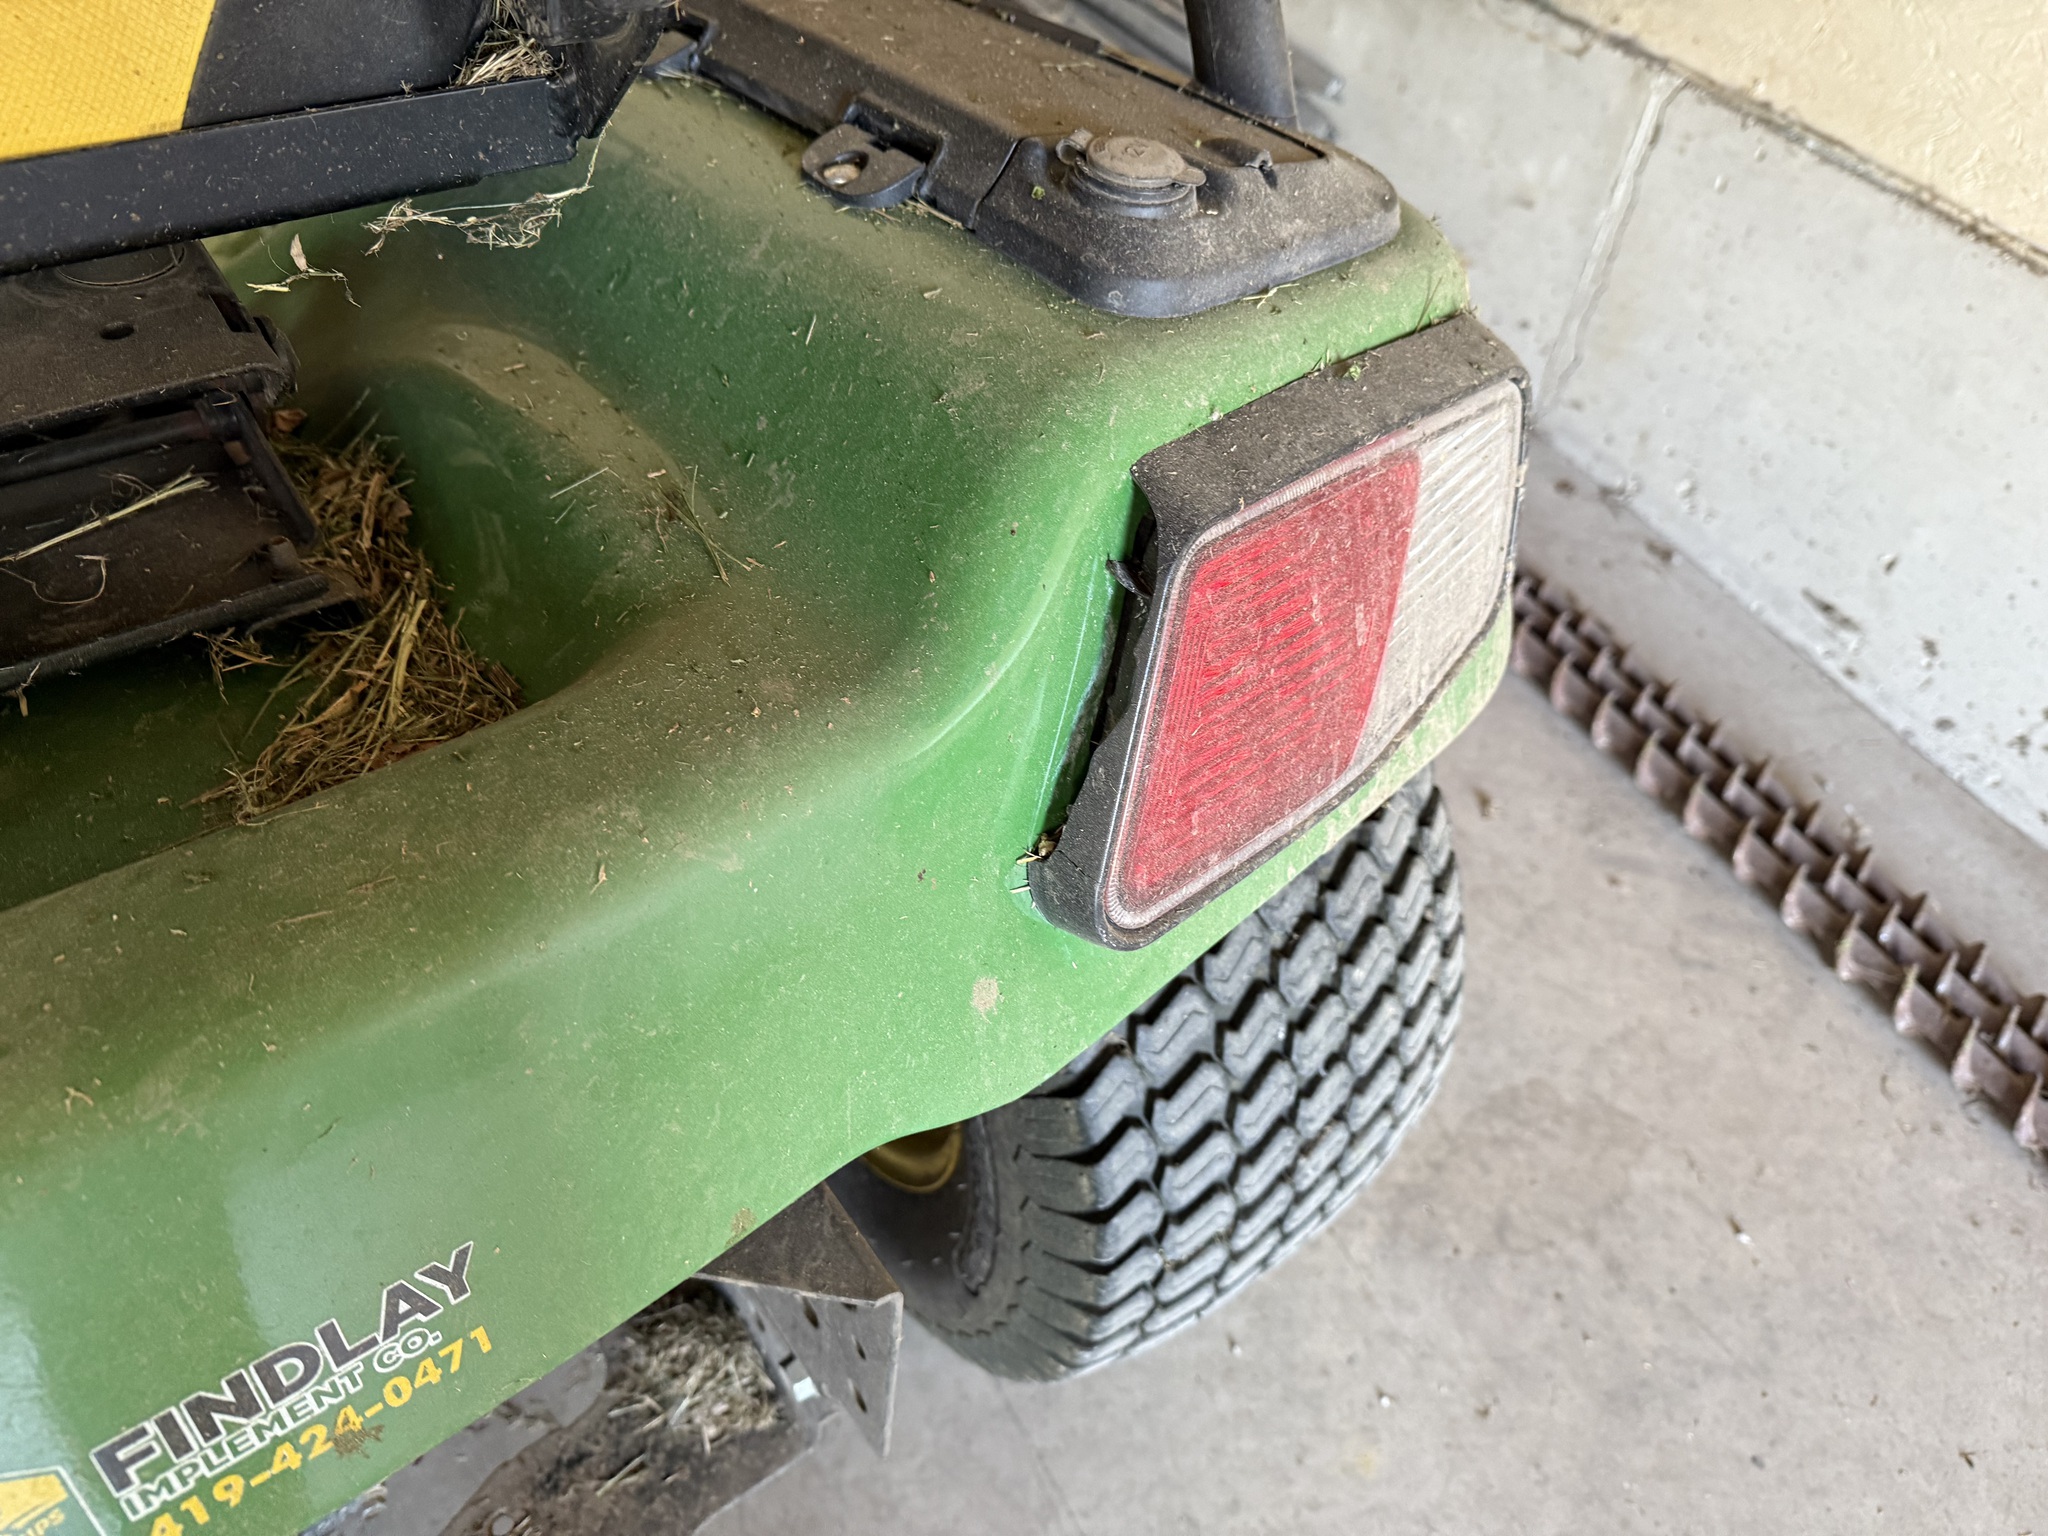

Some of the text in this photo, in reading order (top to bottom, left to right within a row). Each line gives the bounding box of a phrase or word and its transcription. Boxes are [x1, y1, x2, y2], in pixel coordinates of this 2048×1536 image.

[90, 1241, 474, 1497] FINDLAY
[118, 1327, 442, 1522] IMPLEMENT CO.
[151, 1325, 492, 1536] 419-424-0471
